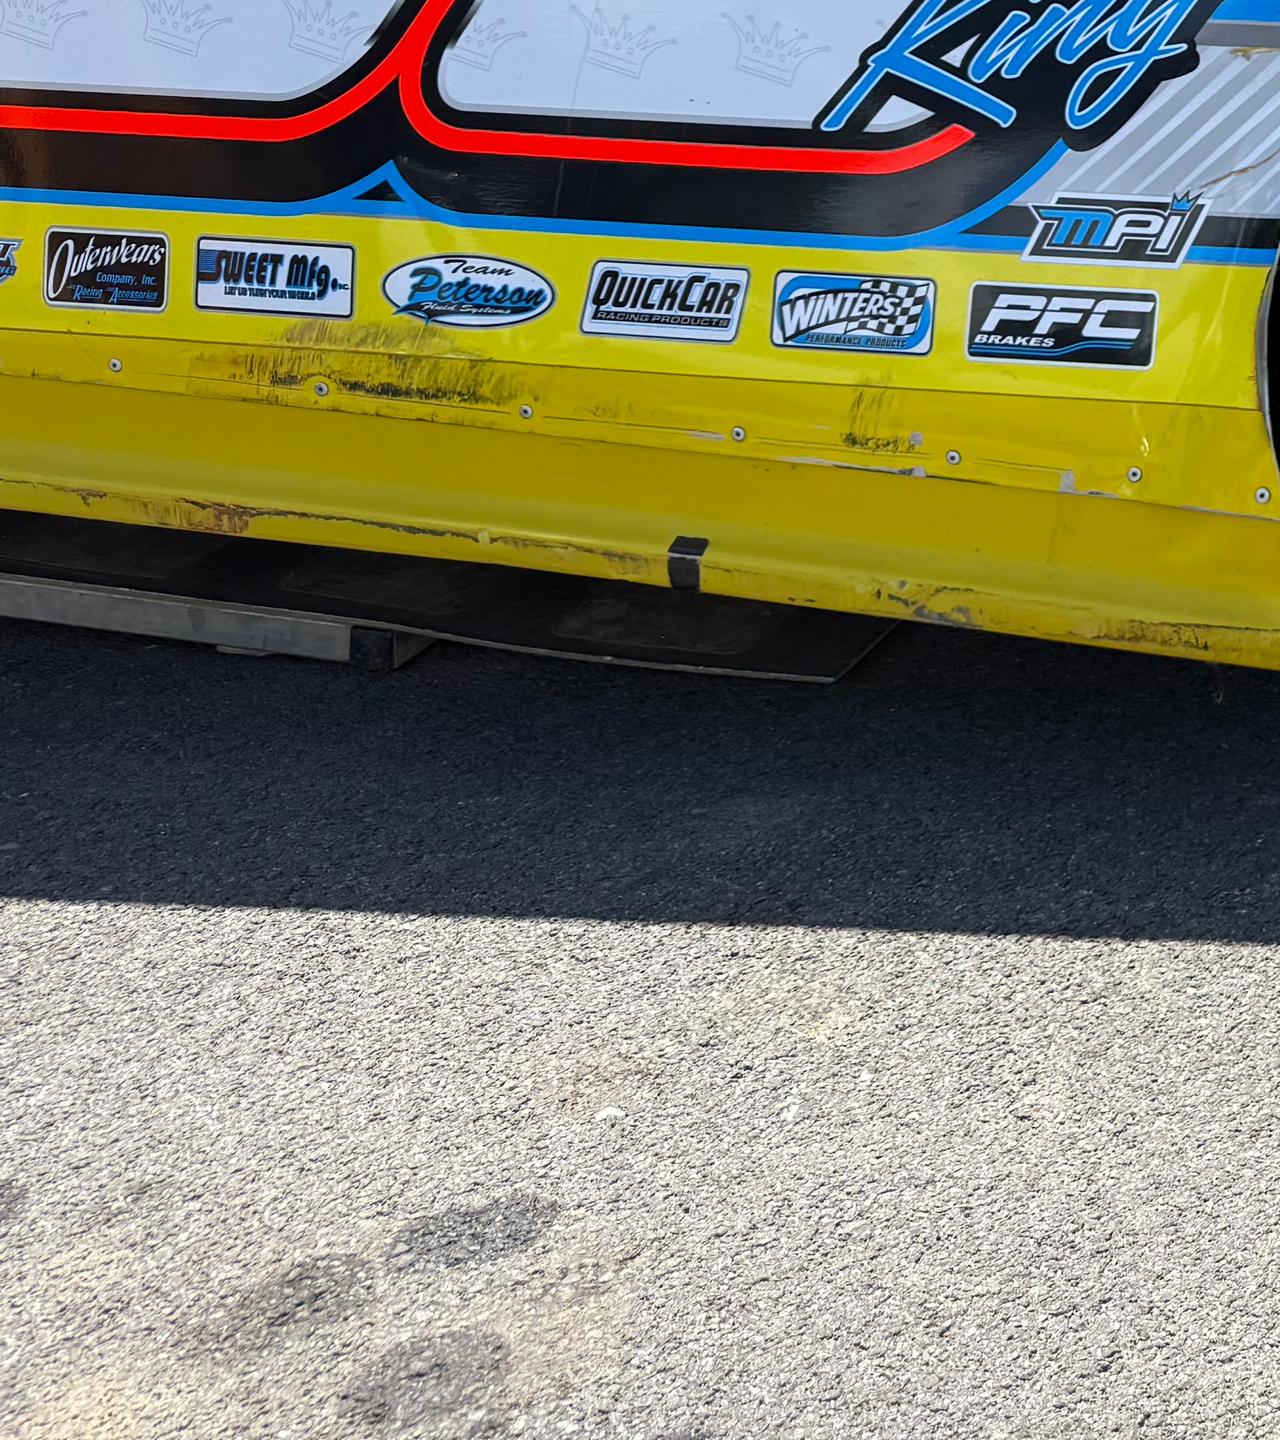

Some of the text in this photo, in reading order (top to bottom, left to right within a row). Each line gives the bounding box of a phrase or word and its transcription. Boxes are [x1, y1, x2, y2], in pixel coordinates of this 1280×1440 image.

[198, 248, 285, 285] SWEET
[443, 259, 515, 277] Team
[95, 271, 138, 286] Company,
[408, 266, 548, 307] Peterson
[73, 284, 159, 304] Racing Accessories
[421, 301, 512, 315] Fluid Systems
[782, 291, 900, 340] WINTERS
[979, 293, 1156, 340] PFC
[596, 311, 729, 329] RACING PRODUCTS
[804, 333, 907, 349] PERFORMANCE PRODUCTS
[973, 333, 1056, 348] BRAKES
